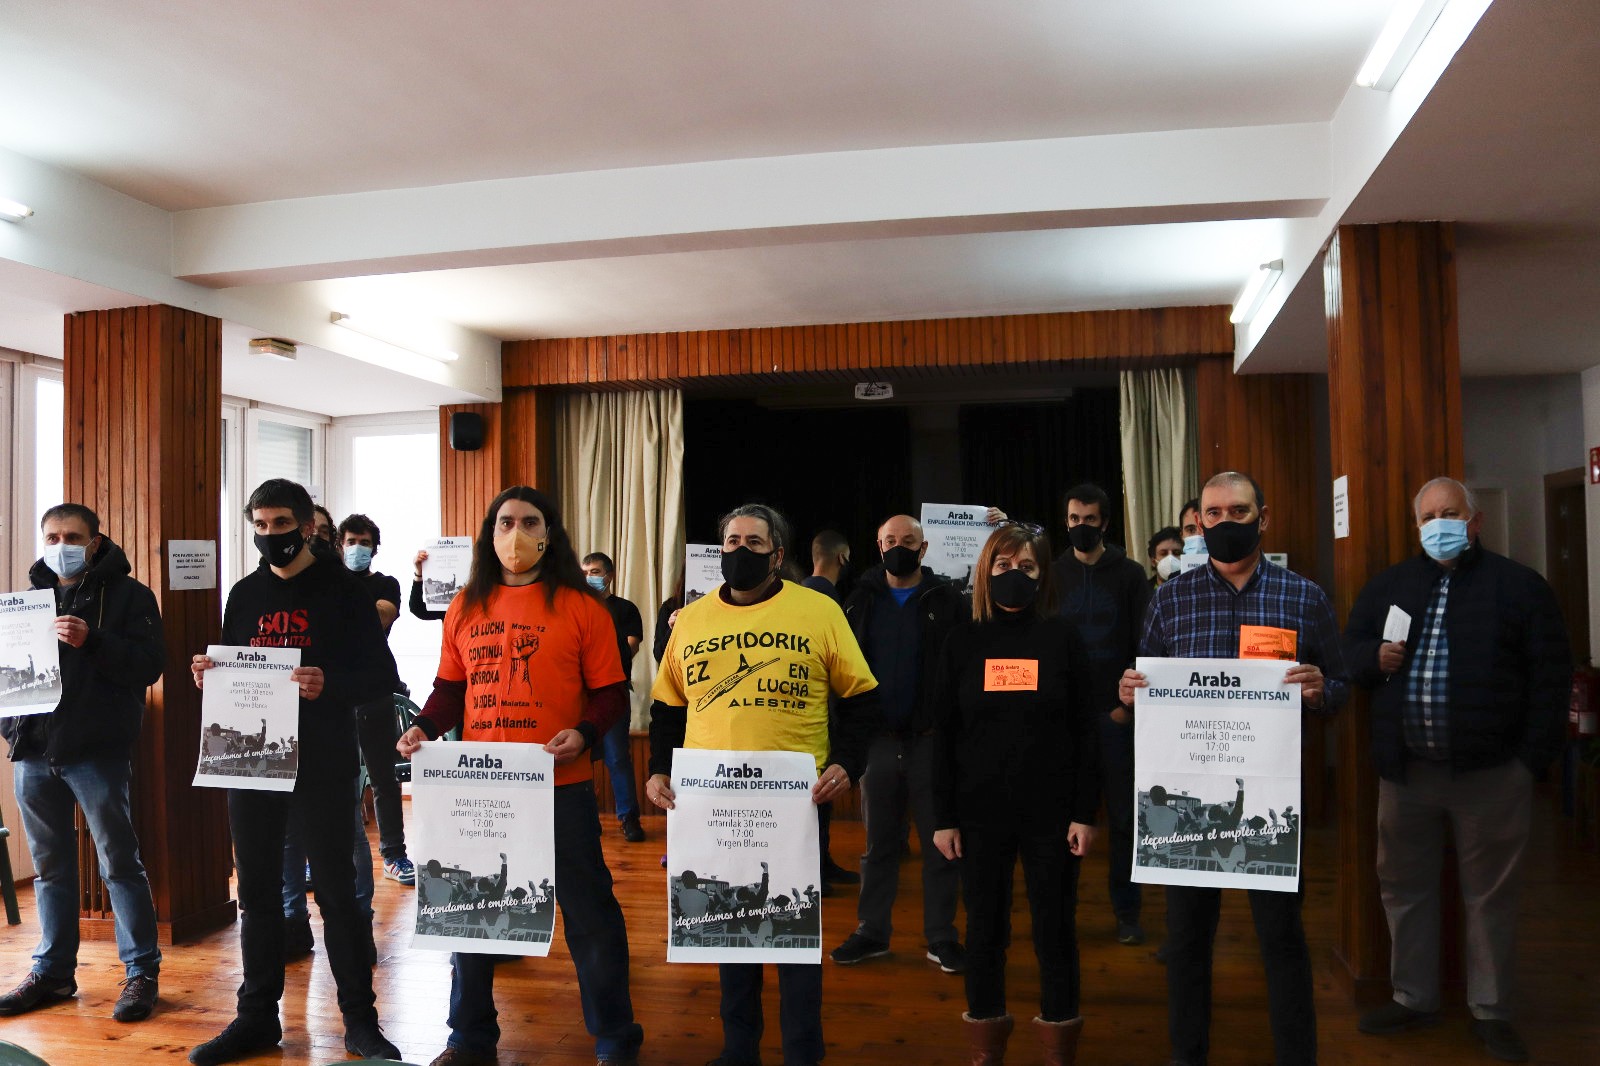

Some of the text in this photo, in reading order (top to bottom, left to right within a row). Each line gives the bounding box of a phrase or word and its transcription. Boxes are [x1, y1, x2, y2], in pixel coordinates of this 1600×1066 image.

[948, 511, 974, 520] Araba
[17, 603, 51, 612] DEFENTSAN
[257, 608, 310, 636] SOS
[511, 623, 531, 631] Mayo
[470, 621, 505, 638] LA LUCHA
[250, 635, 312, 647] OSTALAITZA
[683, 631, 811, 661] DESPIDORIK
[236, 651, 267, 662] Araba
[468, 642, 503, 661] CONTINÚA
[213, 661, 294, 671] ENPLEGUAREN DEFENTSAN
[788, 663, 809, 681] EN
[686, 660, 711, 687] EZ
[1188, 671, 1241, 688] Araba
[757, 677, 809, 697] LUCHA
[1148, 688, 1290, 701] ENPLEGUAREN DEFENTSAN
[728, 697, 807, 709] ALESTIS
[494, 716, 538, 729] Atlantic
[1185, 719, 1251, 731] MANIFESTAZIOA
[1180, 731, 1256, 742] urtarrilak 30 enero
[1205, 742, 1230, 751] 17:00
[243, 749, 250, 758] el
[1189, 752, 1245, 764] Virgen Blanca
[457, 753, 503, 769] Araba
[423, 769, 545, 782] ENPLEGUAREN DEFENTSAN
[715, 763, 763, 778] Araba
[680, 778, 809, 790] ENPLEGUAREN DEFENTSAN
[455, 798, 511, 809] MANIFESTAZIOA
[450, 809, 516, 819] urtarrilak 30 enero
[712, 808, 773, 819] MANIFESTAZIOA
[472, 819, 494, 828] 17:00
[707, 819, 778, 829] urtarrilak 30 enero
[459, 828, 507, 839] Virgen Blanca
[731, 829, 754, 838] 17:00
[1141, 823, 1292, 849] defendamos el empleo digno
[716, 838, 769, 849] Virgen Blanca
[420, 895, 548, 918] defendamos el empleo digno
[675, 901, 813, 929] defendamos el empleo digno
